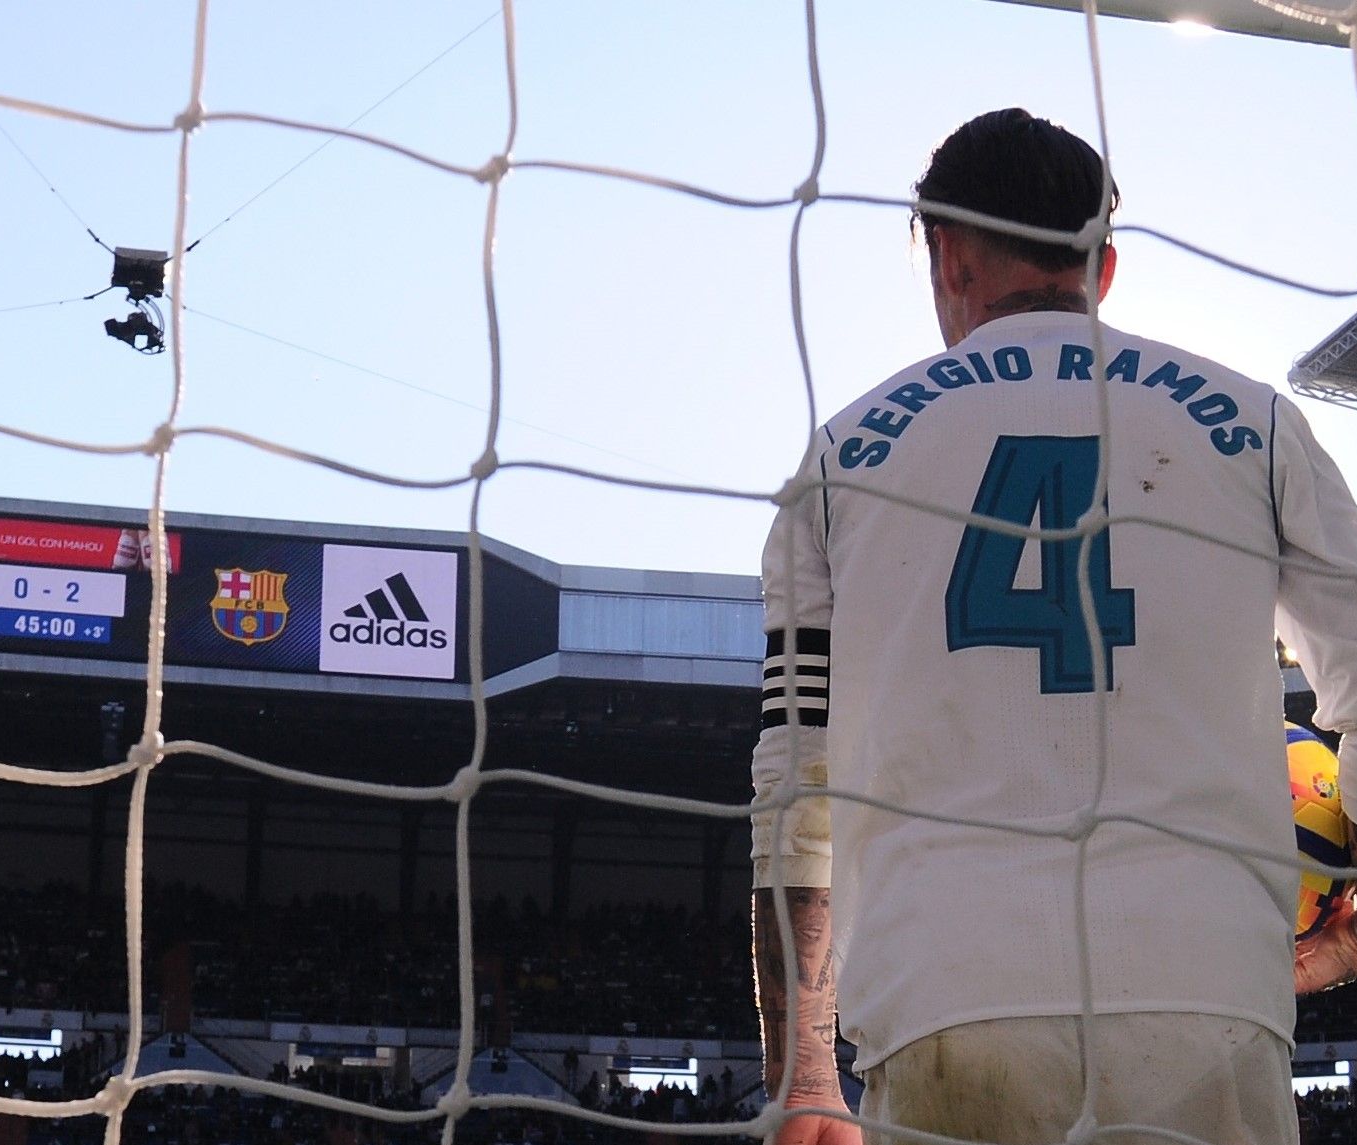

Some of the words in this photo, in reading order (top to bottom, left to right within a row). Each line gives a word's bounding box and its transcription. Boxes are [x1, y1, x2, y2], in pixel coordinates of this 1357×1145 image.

[839, 345, 1033, 470] SERGIO
[1057, 343, 1264, 457] RAMOS
[1, 534, 16, 545] UN
[17, 535, 38, 547] GOL
[39, 537, 62, 549] CON
[63, 539, 104, 552] MAHOU
[945, 434, 1136, 695] 4
[13, 577, 29, 599] 0
[65, 582, 80, 603] 2
[13, 615, 76, 637] 45:00
[329, 618, 448, 649] adidas
